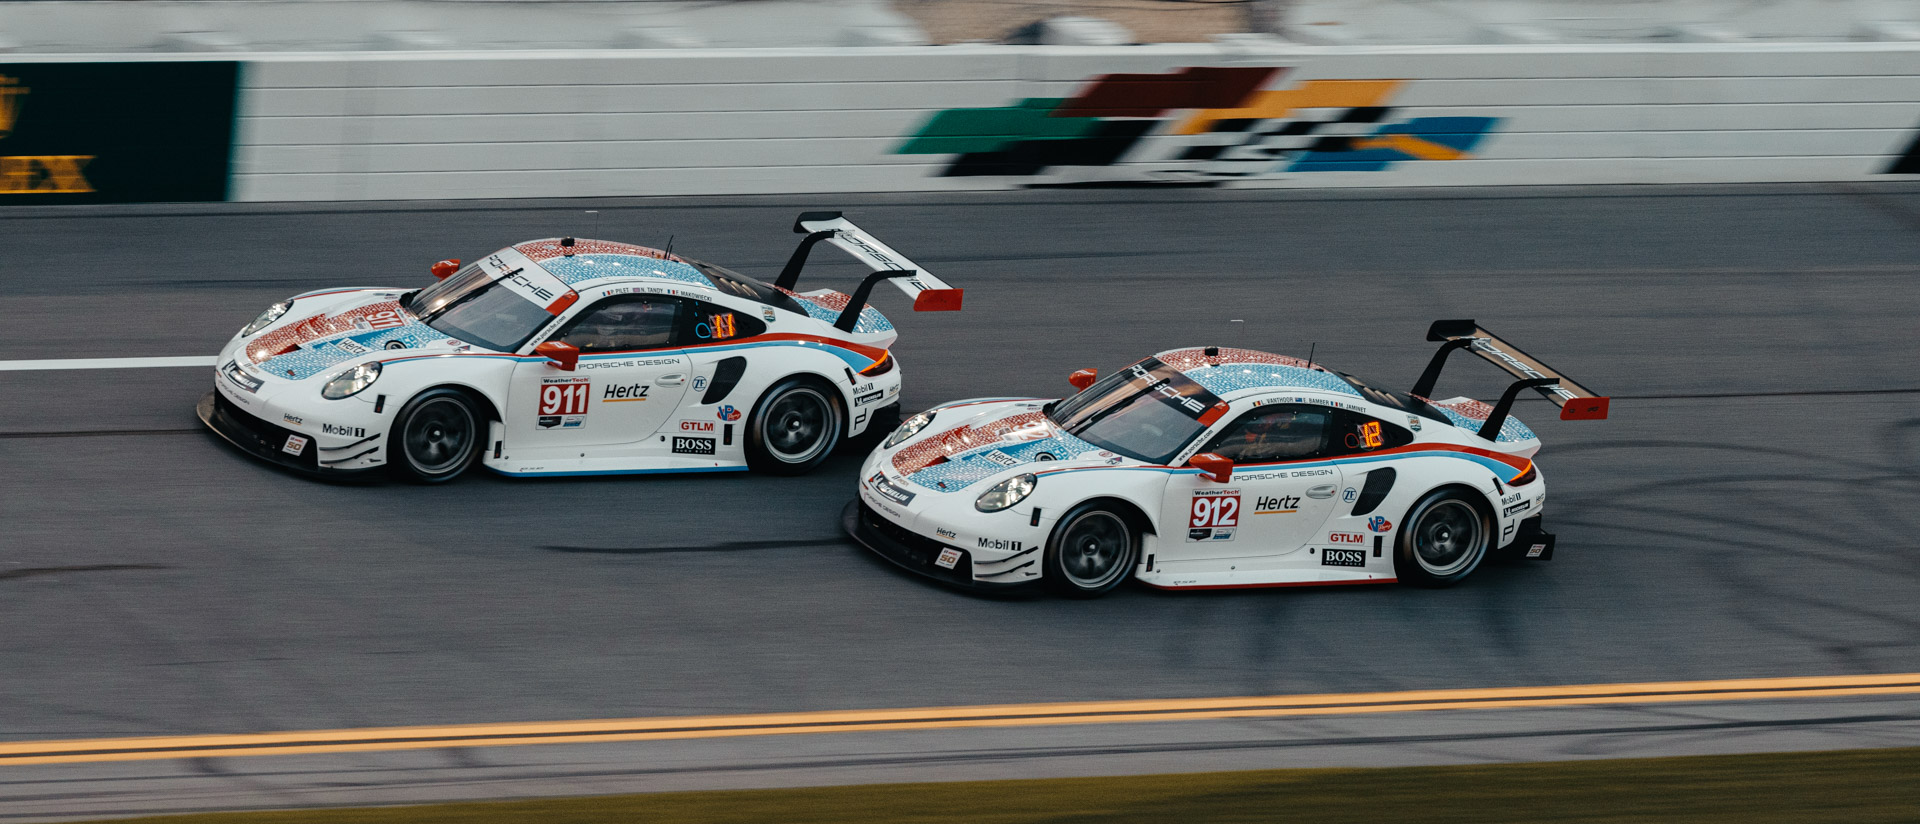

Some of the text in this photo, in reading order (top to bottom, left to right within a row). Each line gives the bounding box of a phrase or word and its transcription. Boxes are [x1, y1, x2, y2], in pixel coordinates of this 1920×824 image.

[680, 290, 712, 302] MAKOWIECKI
[341, 338, 366, 354] Hertz
[578, 359, 680, 370] PORSCHE DESIGN
[694, 379, 706, 389] ZF
[853, 384, 869, 394] Mobil
[604, 384, 649, 398] Hertz
[542, 385, 587, 414] 911
[717, 405, 734, 421] VP
[1346, 404, 1366, 413] JAMINET
[284, 413, 303, 424] Hertz
[322, 424, 353, 436] Mobil
[681, 421, 714, 431] GTLM
[1363, 421, 1382, 447] 12
[676, 438, 712, 450] BOSS
[988, 451, 1017, 466] Hertz
[1234, 469, 1333, 481] PORSCHE DESIGN
[877, 483, 909, 501] MICHELIN
[1344, 490, 1356, 501] ZF
[1256, 495, 1300, 511] Hertz
[1193, 497, 1238, 527] 912
[1368, 516, 1385, 532] VP
[937, 527, 957, 539] Hertz
[1330, 533, 1364, 543] GTLM
[978, 538, 1009, 550] Mobil
[1326, 551, 1362, 562] BOSS
